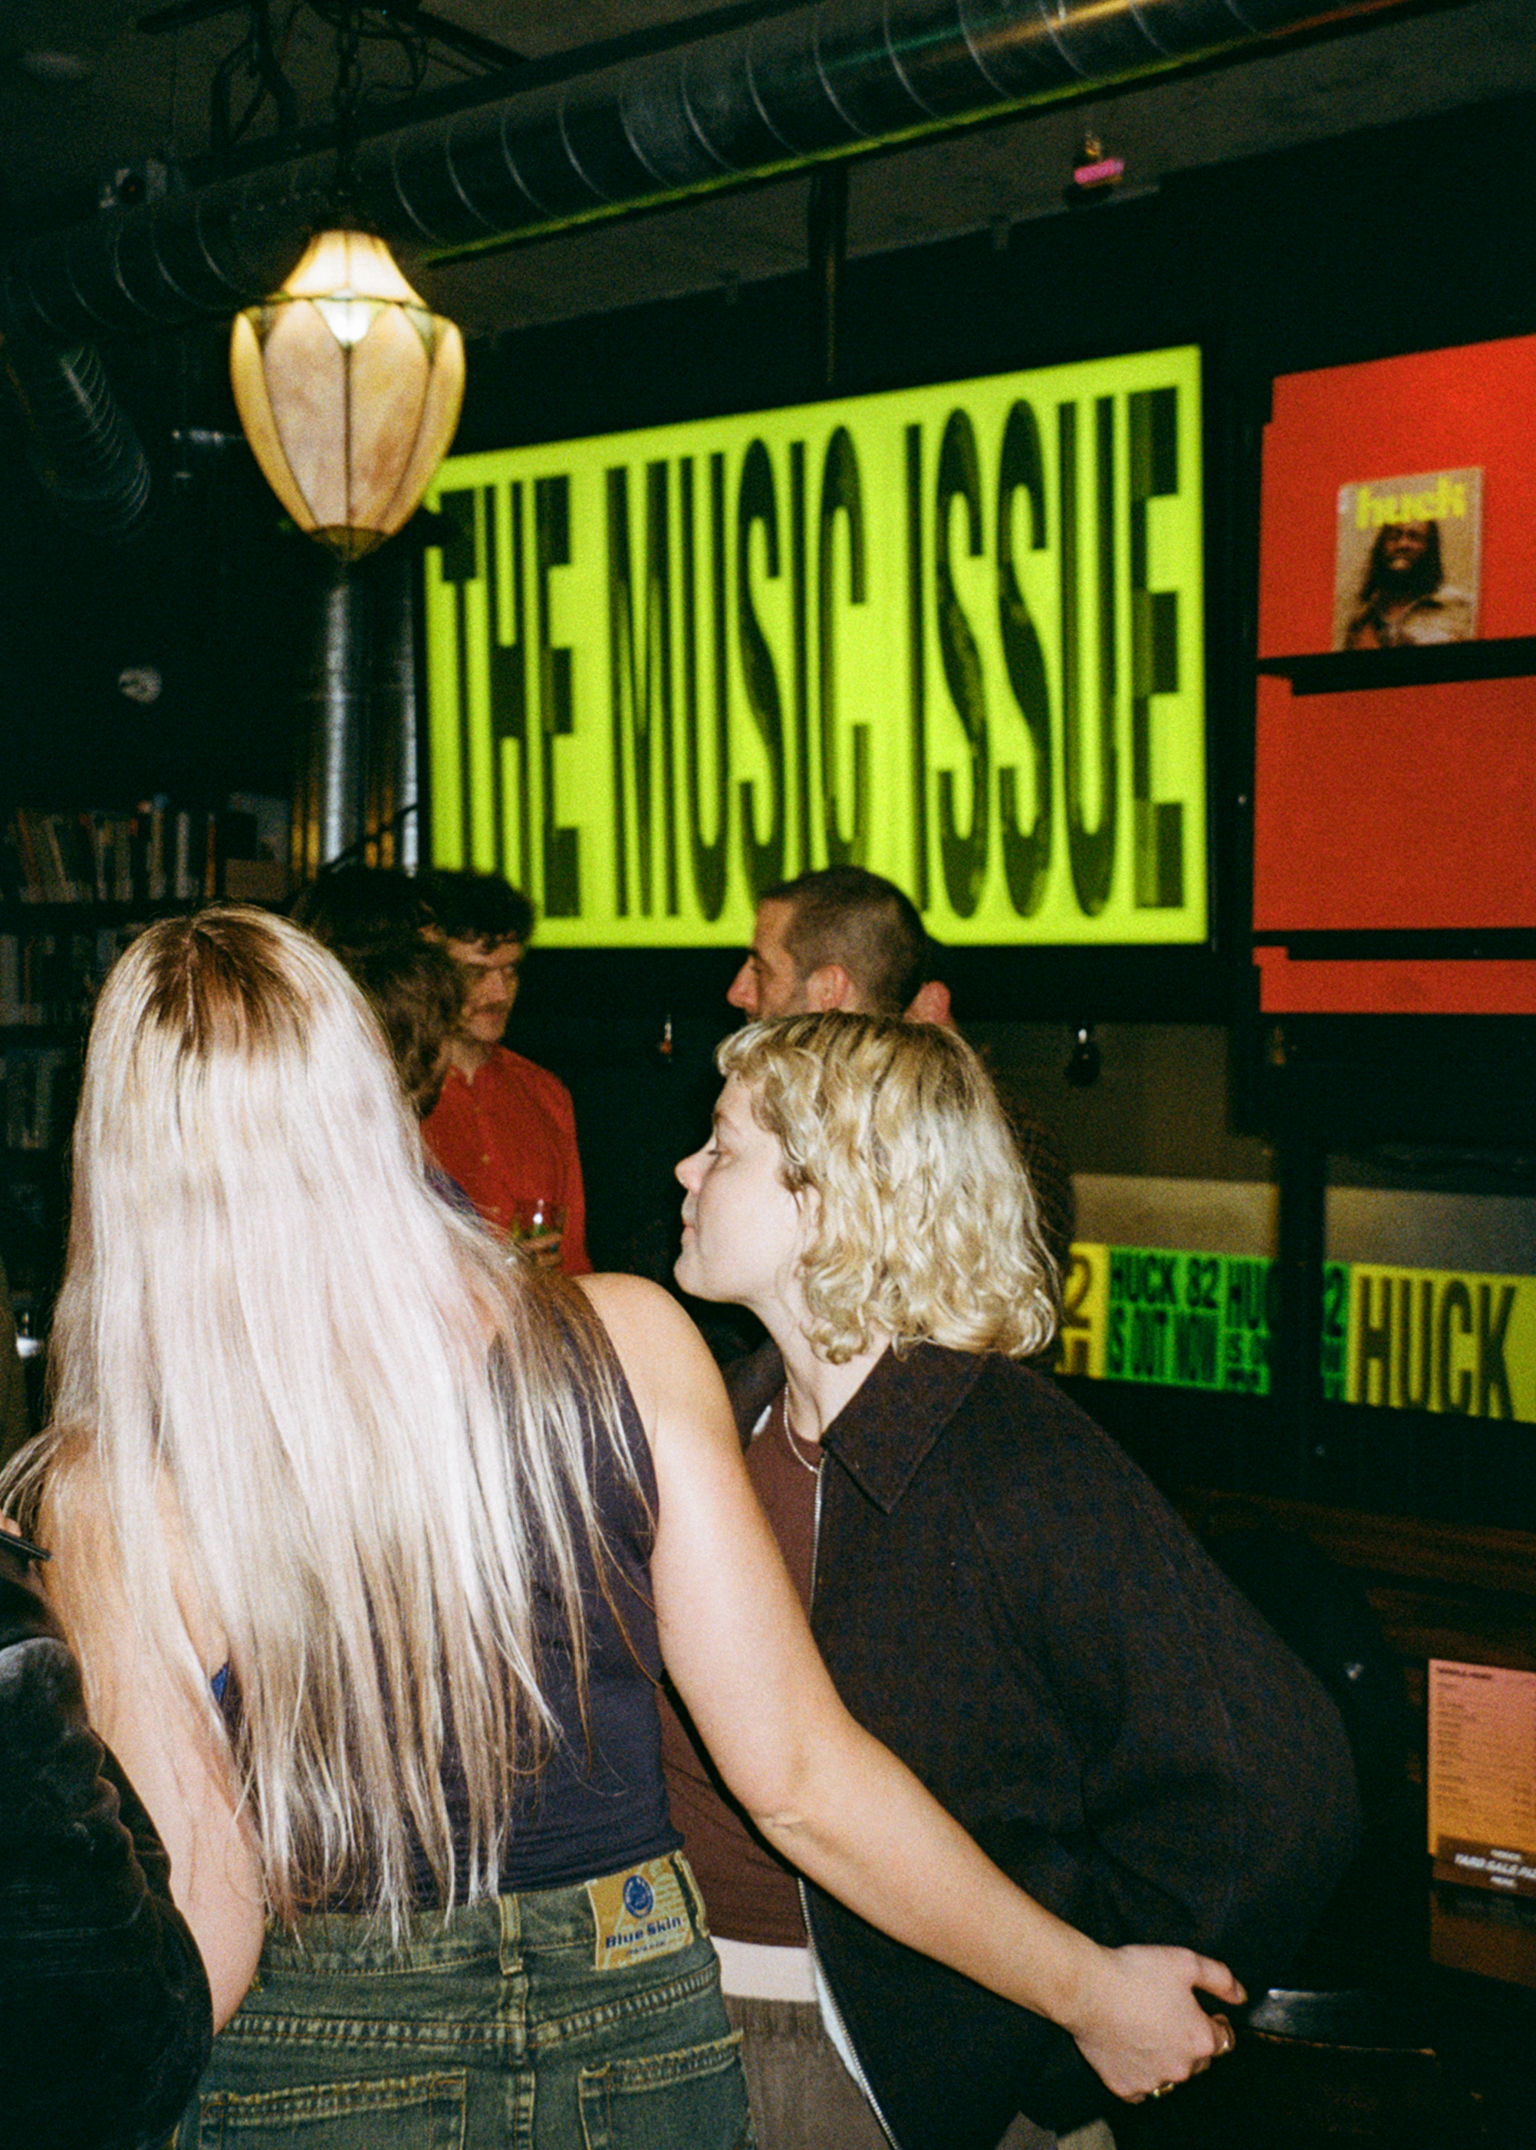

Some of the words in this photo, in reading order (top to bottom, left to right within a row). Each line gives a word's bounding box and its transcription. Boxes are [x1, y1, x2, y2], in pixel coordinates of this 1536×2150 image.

[1355, 475, 1467, 530] huck
[438, 473, 581, 919] THE
[605, 424, 870, 922] MUSIC
[904, 385, 1185, 920] ISSUE
[1062, 1253, 1091, 1327] 2
[1359, 1273, 1517, 1420] HUCK
[605, 1929, 643, 1949] Blue
[646, 1917, 682, 1936] Skin
